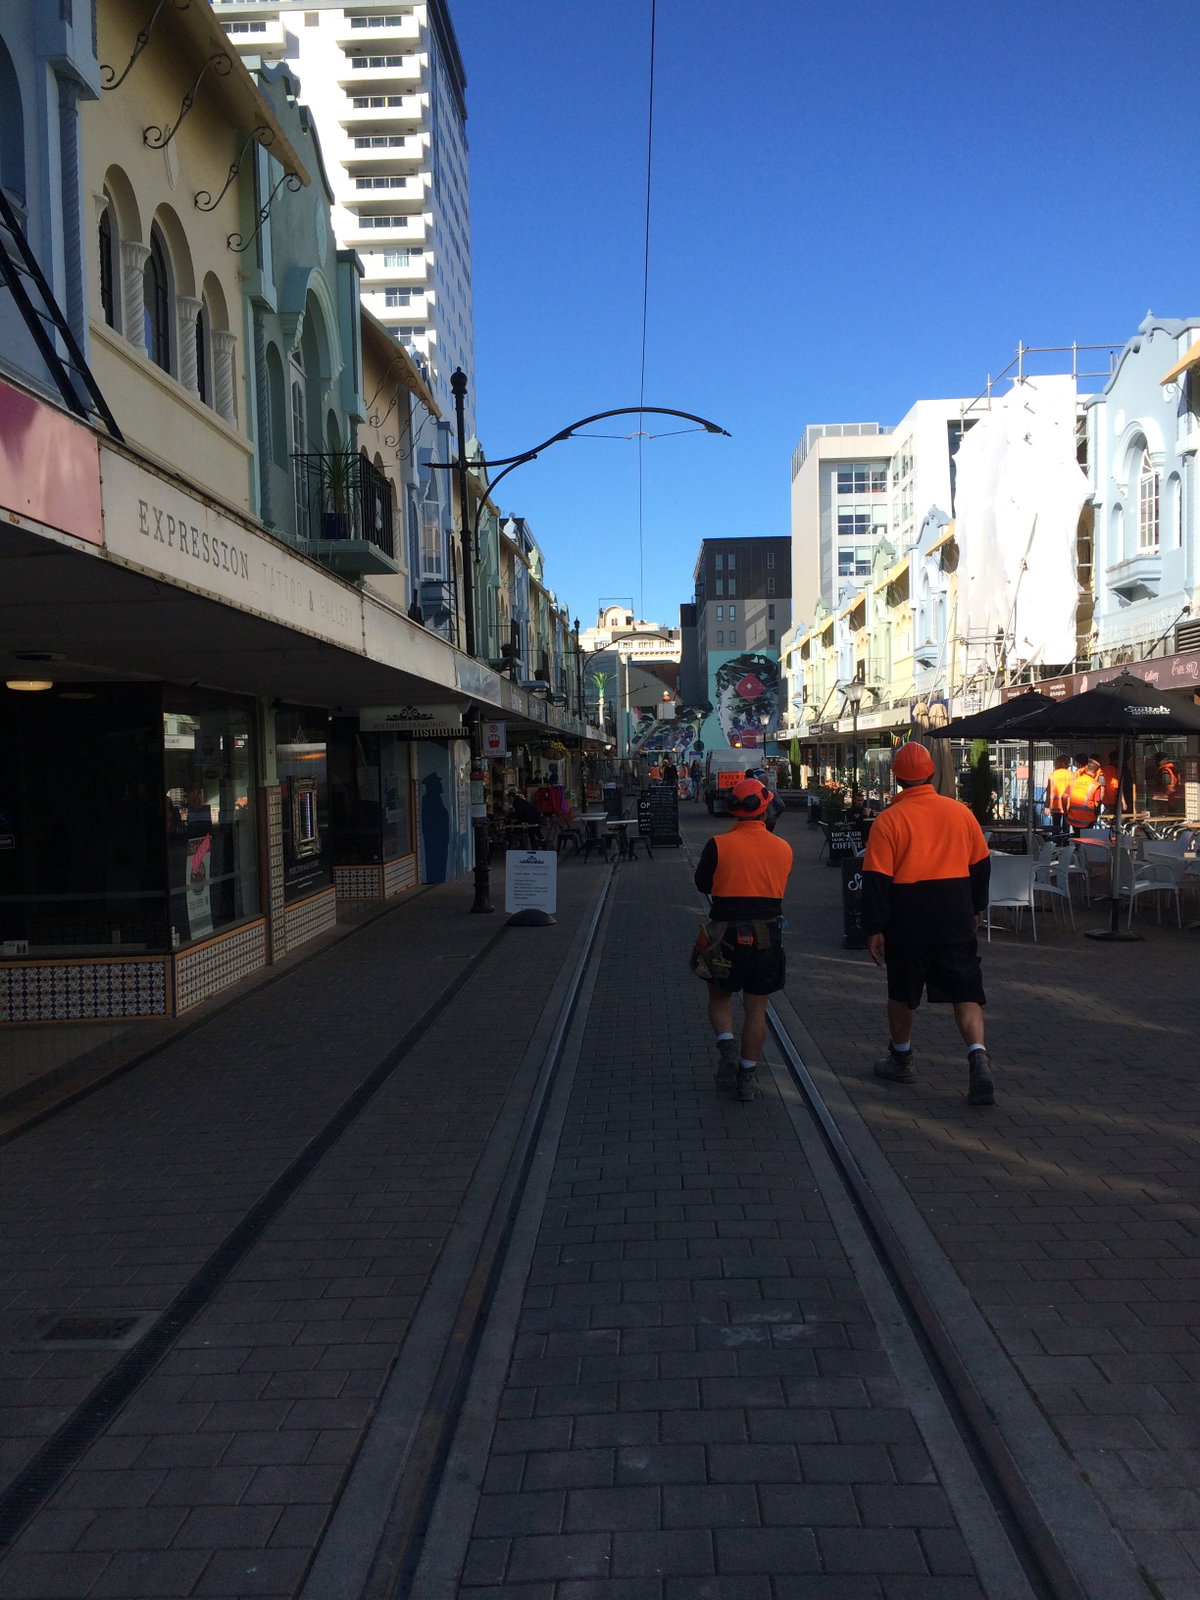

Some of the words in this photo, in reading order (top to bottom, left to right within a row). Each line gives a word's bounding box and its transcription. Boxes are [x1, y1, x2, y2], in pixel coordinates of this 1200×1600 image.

[138, 499, 249, 581] EXPRESSION
[262, 563, 302, 606] TATTOO
[1124, 705, 1171, 713] Switch
